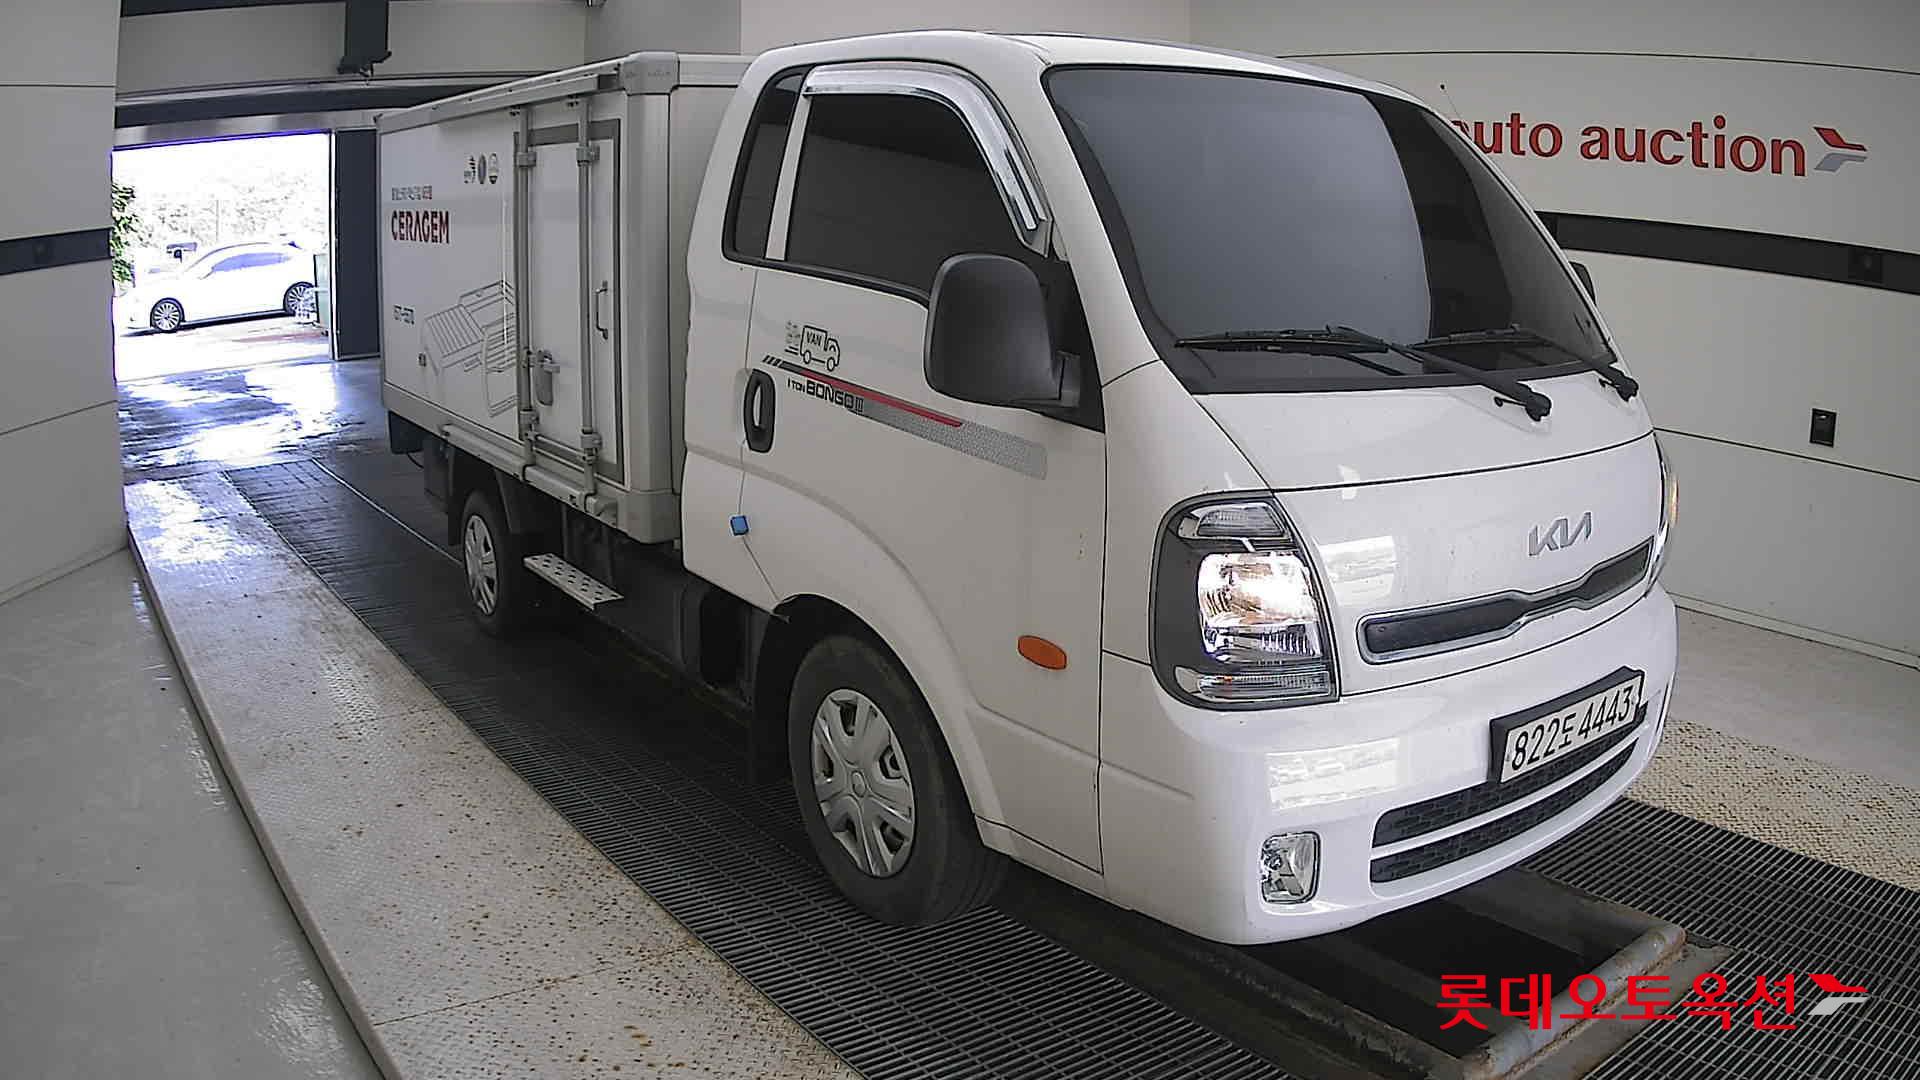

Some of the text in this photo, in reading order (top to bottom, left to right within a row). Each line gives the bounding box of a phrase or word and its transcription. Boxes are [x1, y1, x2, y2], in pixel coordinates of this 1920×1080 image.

[1580, 115, 1806, 177] auction
[391, 210, 450, 244] CERAGEM
[807, 331, 822, 346] VAN
[1528, 511, 1592, 557] KIA
